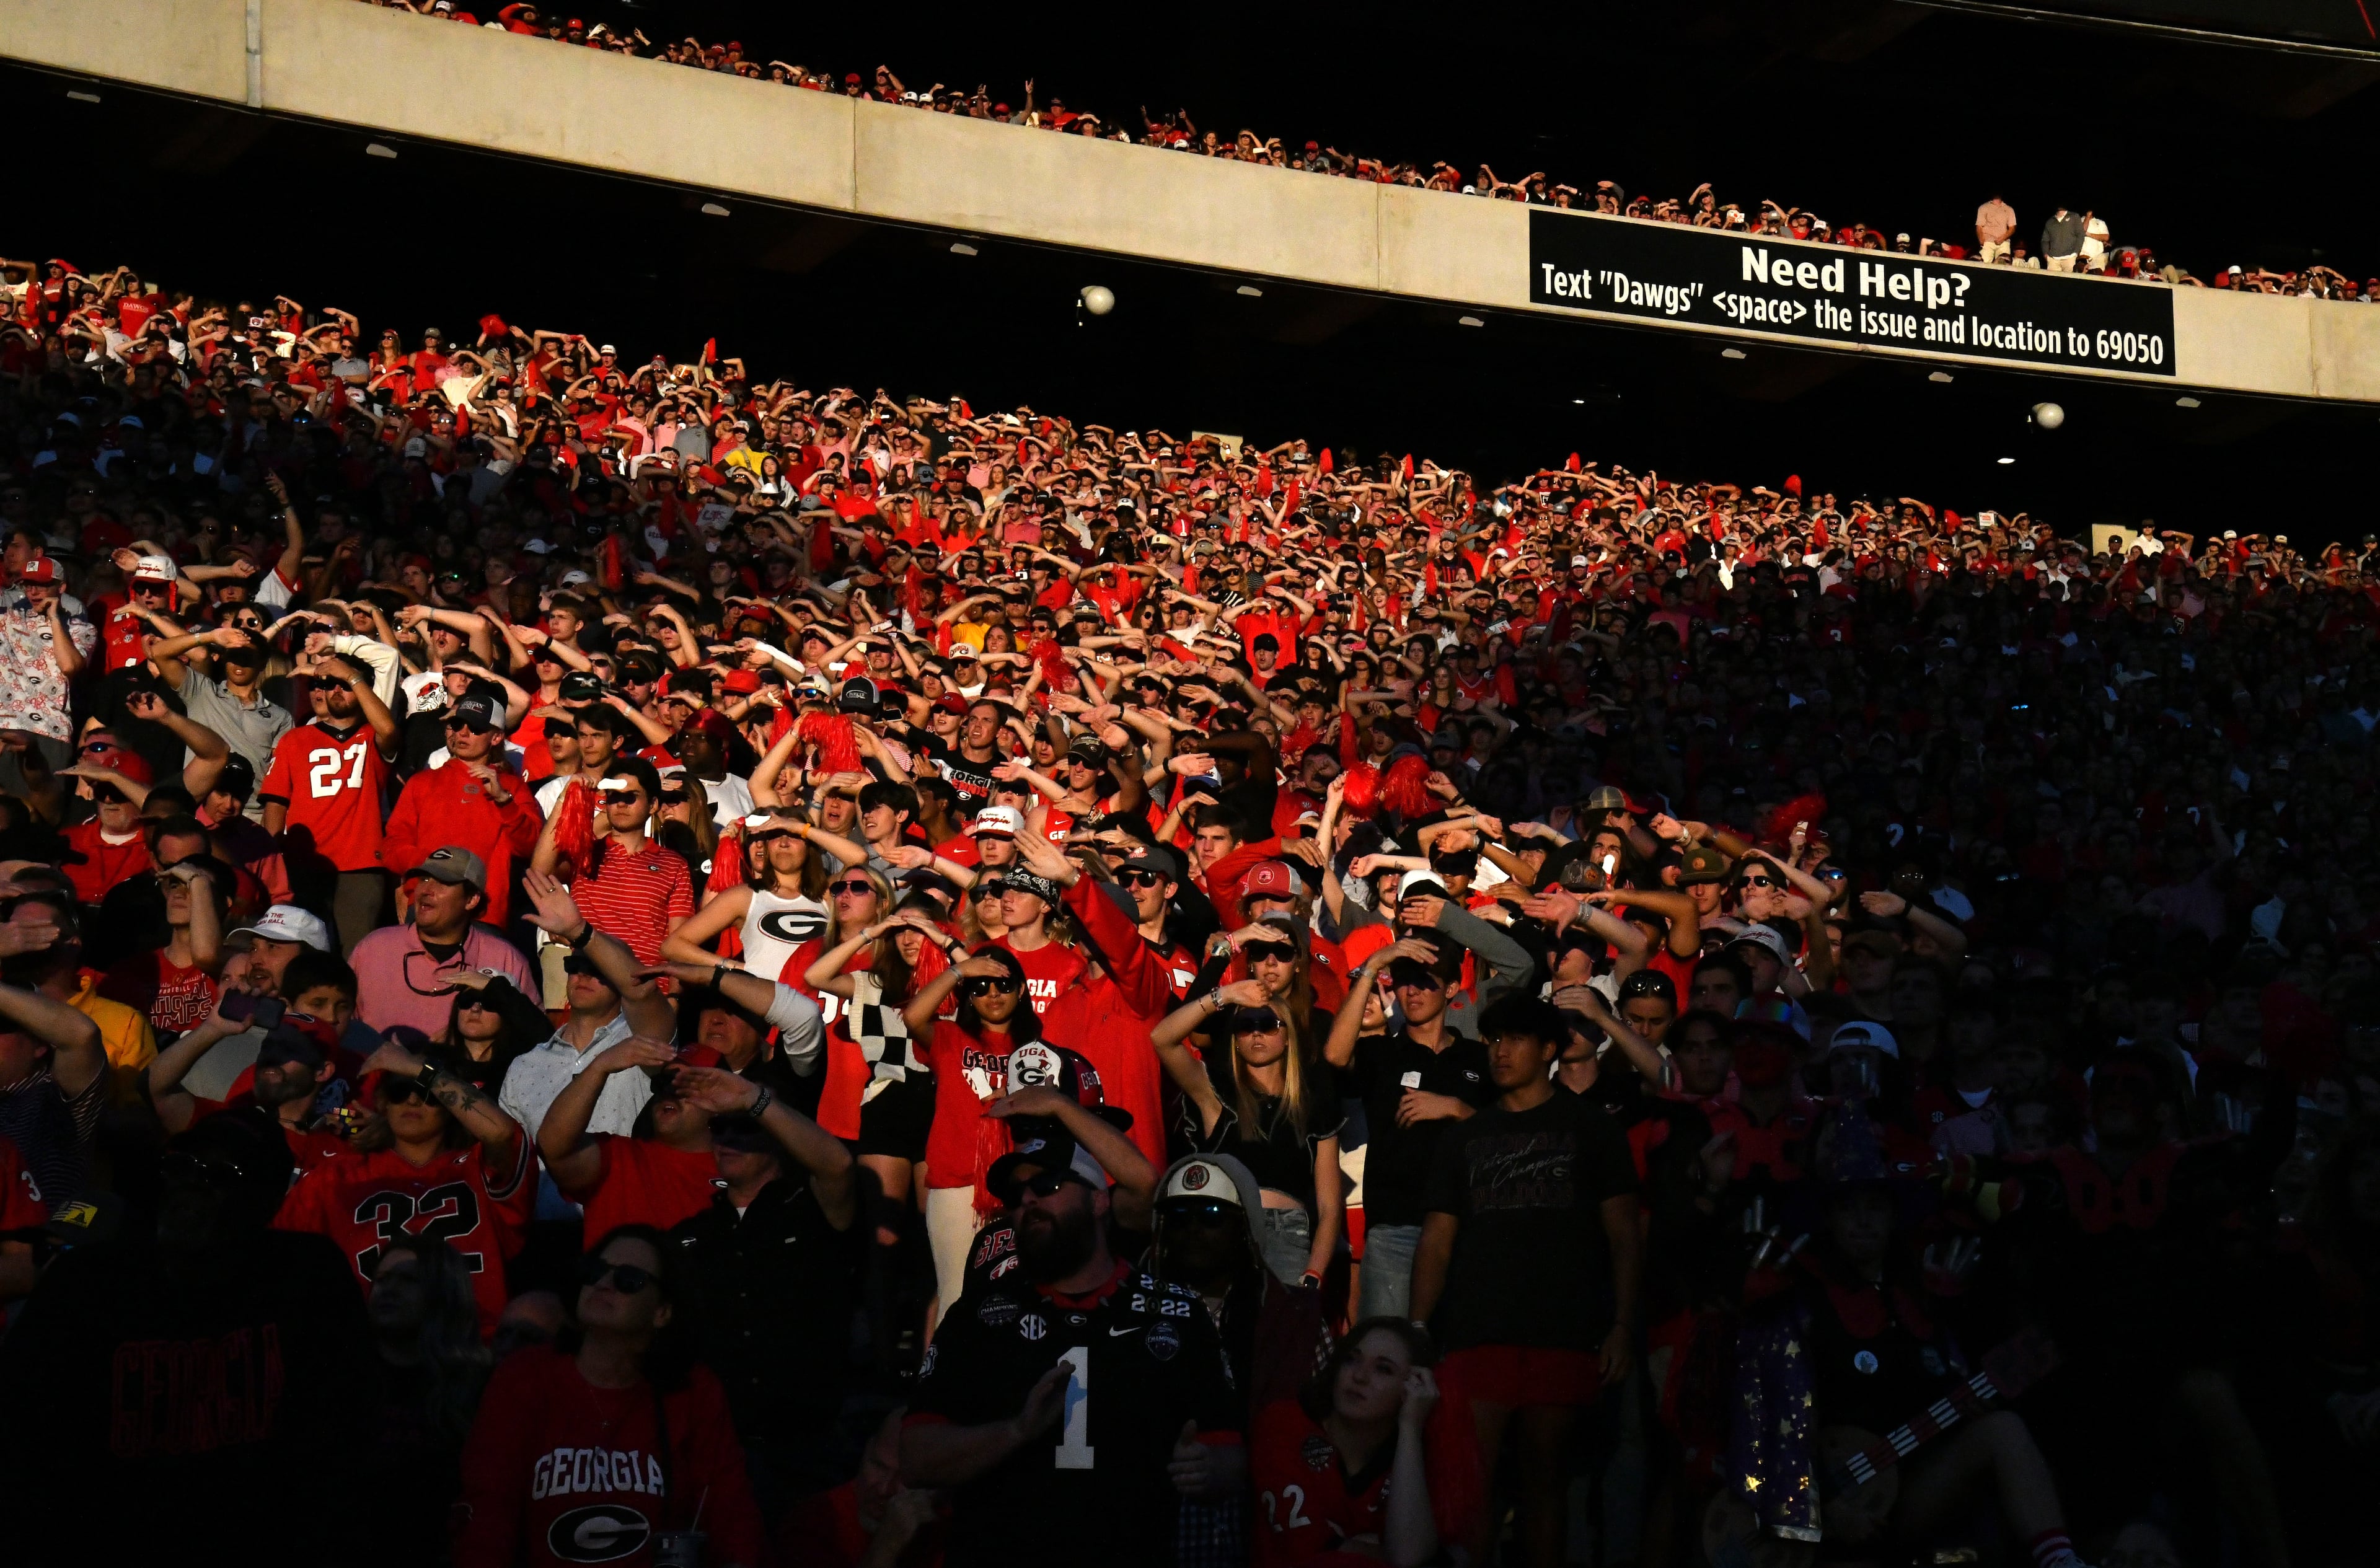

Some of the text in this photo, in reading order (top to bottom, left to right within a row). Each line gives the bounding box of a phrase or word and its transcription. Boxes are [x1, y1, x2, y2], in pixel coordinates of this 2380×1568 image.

[1742, 246, 1971, 310] Need Help?
[1541, 263, 2164, 365] Text "Dawgs" <space> the issue and location to 69050
[309, 740, 368, 799] 27
[951, 778, 989, 799] ENNIS
[769, 914, 831, 940] G
[159, 985, 190, 995] FOOTBALL
[1019, 1048, 1049, 1059] UGA
[1020, 1068, 1046, 1085] G
[21, 1170, 42, 1202] 3
[355, 1180, 485, 1284] 32
[1019, 1313, 1047, 1341] SEC
[1055, 1346, 1095, 1469] 1
[532, 1445, 666, 1501] GEORGIA
[1261, 1484, 1312, 1533] 22
[561, 1510, 650, 1557] G
